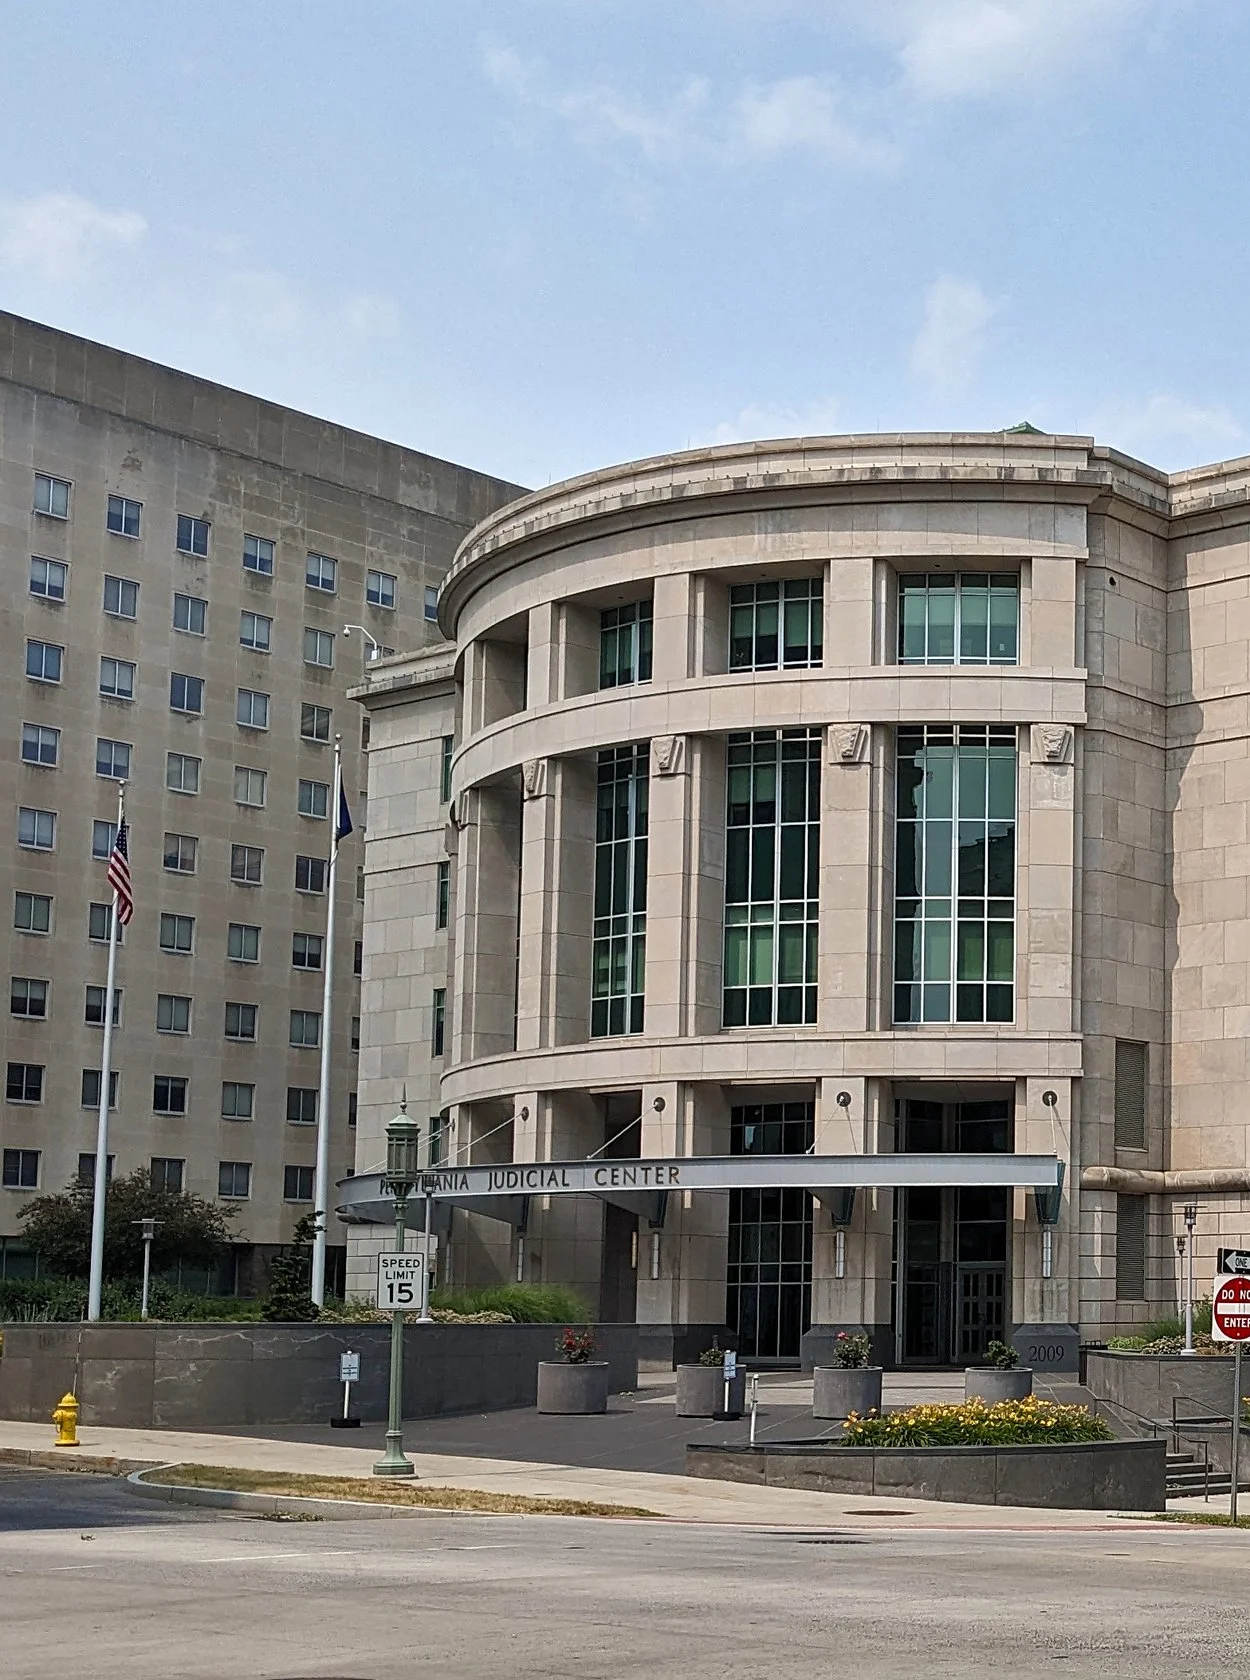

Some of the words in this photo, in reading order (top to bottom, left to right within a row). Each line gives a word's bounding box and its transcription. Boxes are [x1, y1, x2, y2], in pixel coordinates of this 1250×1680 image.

[488, 1169, 570, 1192] JUDICIAL
[594, 1166, 680, 1186] CENTER
[382, 1259, 420, 1268] SPEED
[1235, 1257, 1248, 1268] ONE
[385, 1270, 416, 1280] LIMIT
[387, 1282, 414, 1304] 15
[1221, 1289, 1235, 1300] DO
[1029, 1345, 1065, 1362] 2009
